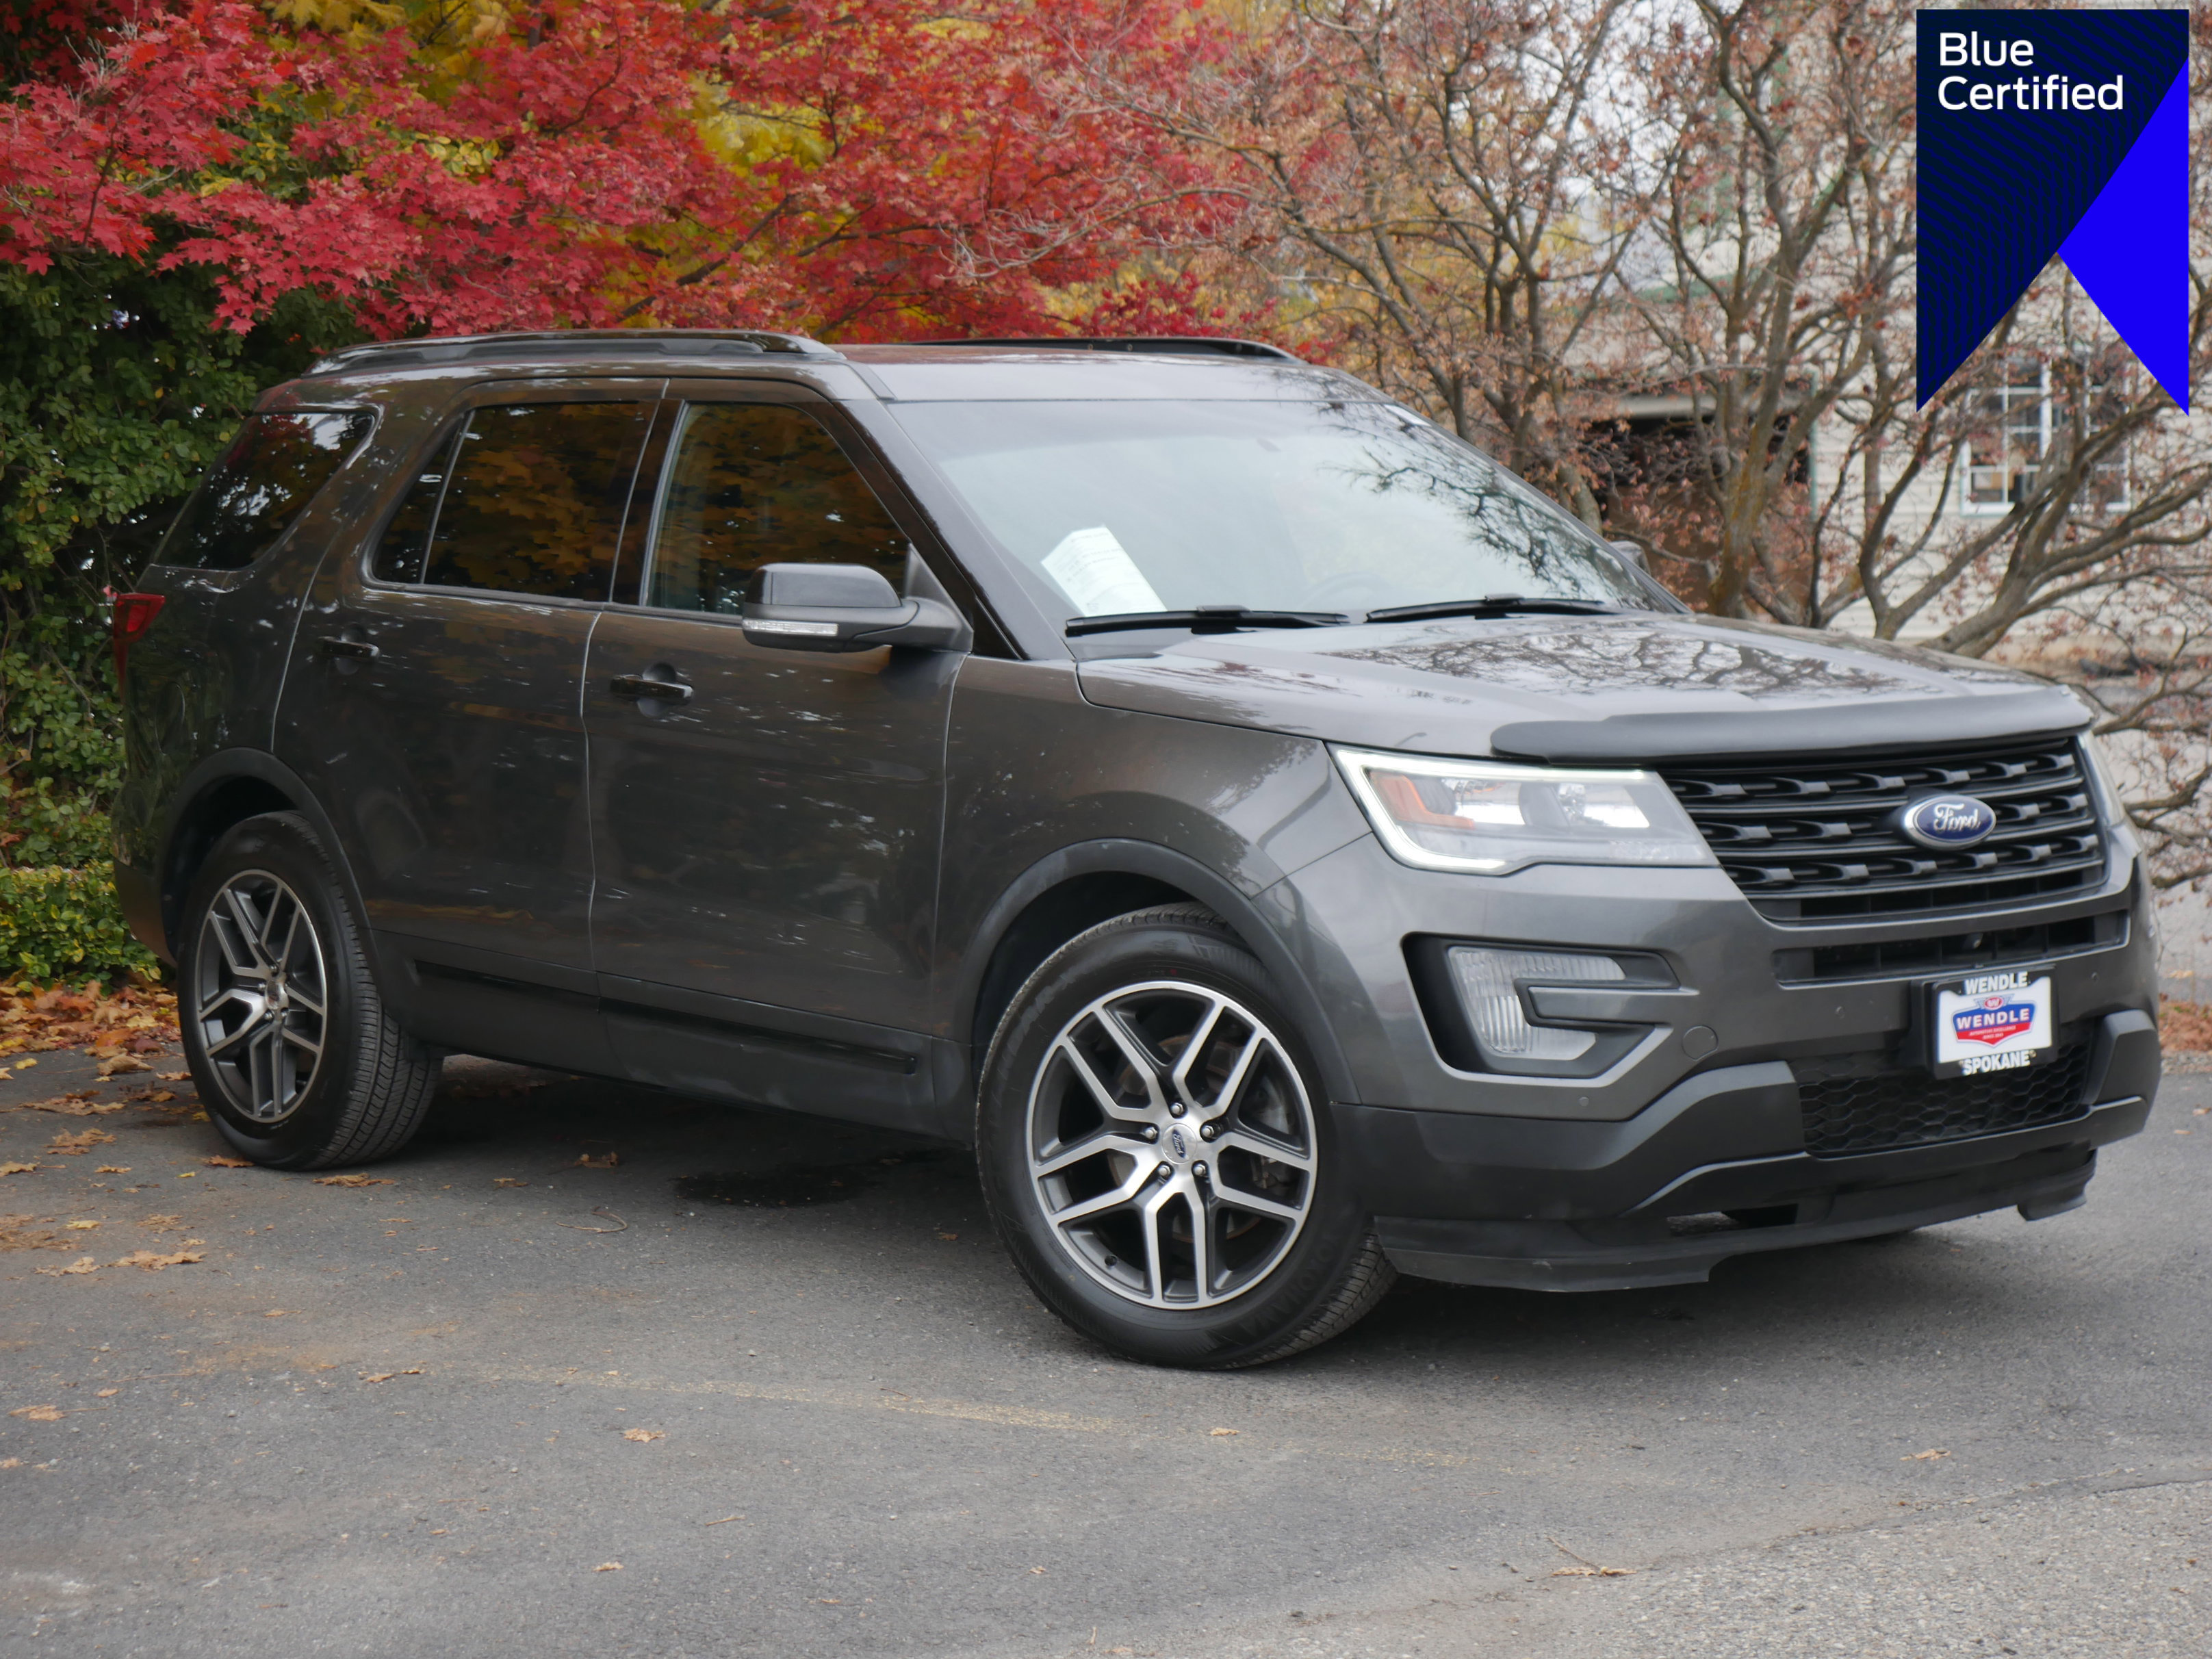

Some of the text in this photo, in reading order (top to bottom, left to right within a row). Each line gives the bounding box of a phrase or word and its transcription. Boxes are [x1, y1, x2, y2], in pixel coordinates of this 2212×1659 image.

[1933, 803, 1981, 831] Ford
[1965, 971, 2028, 994] WENDLE
[1956, 1007, 2030, 1030] WENDLE
[1962, 1050, 2031, 1076] SPOKANE
